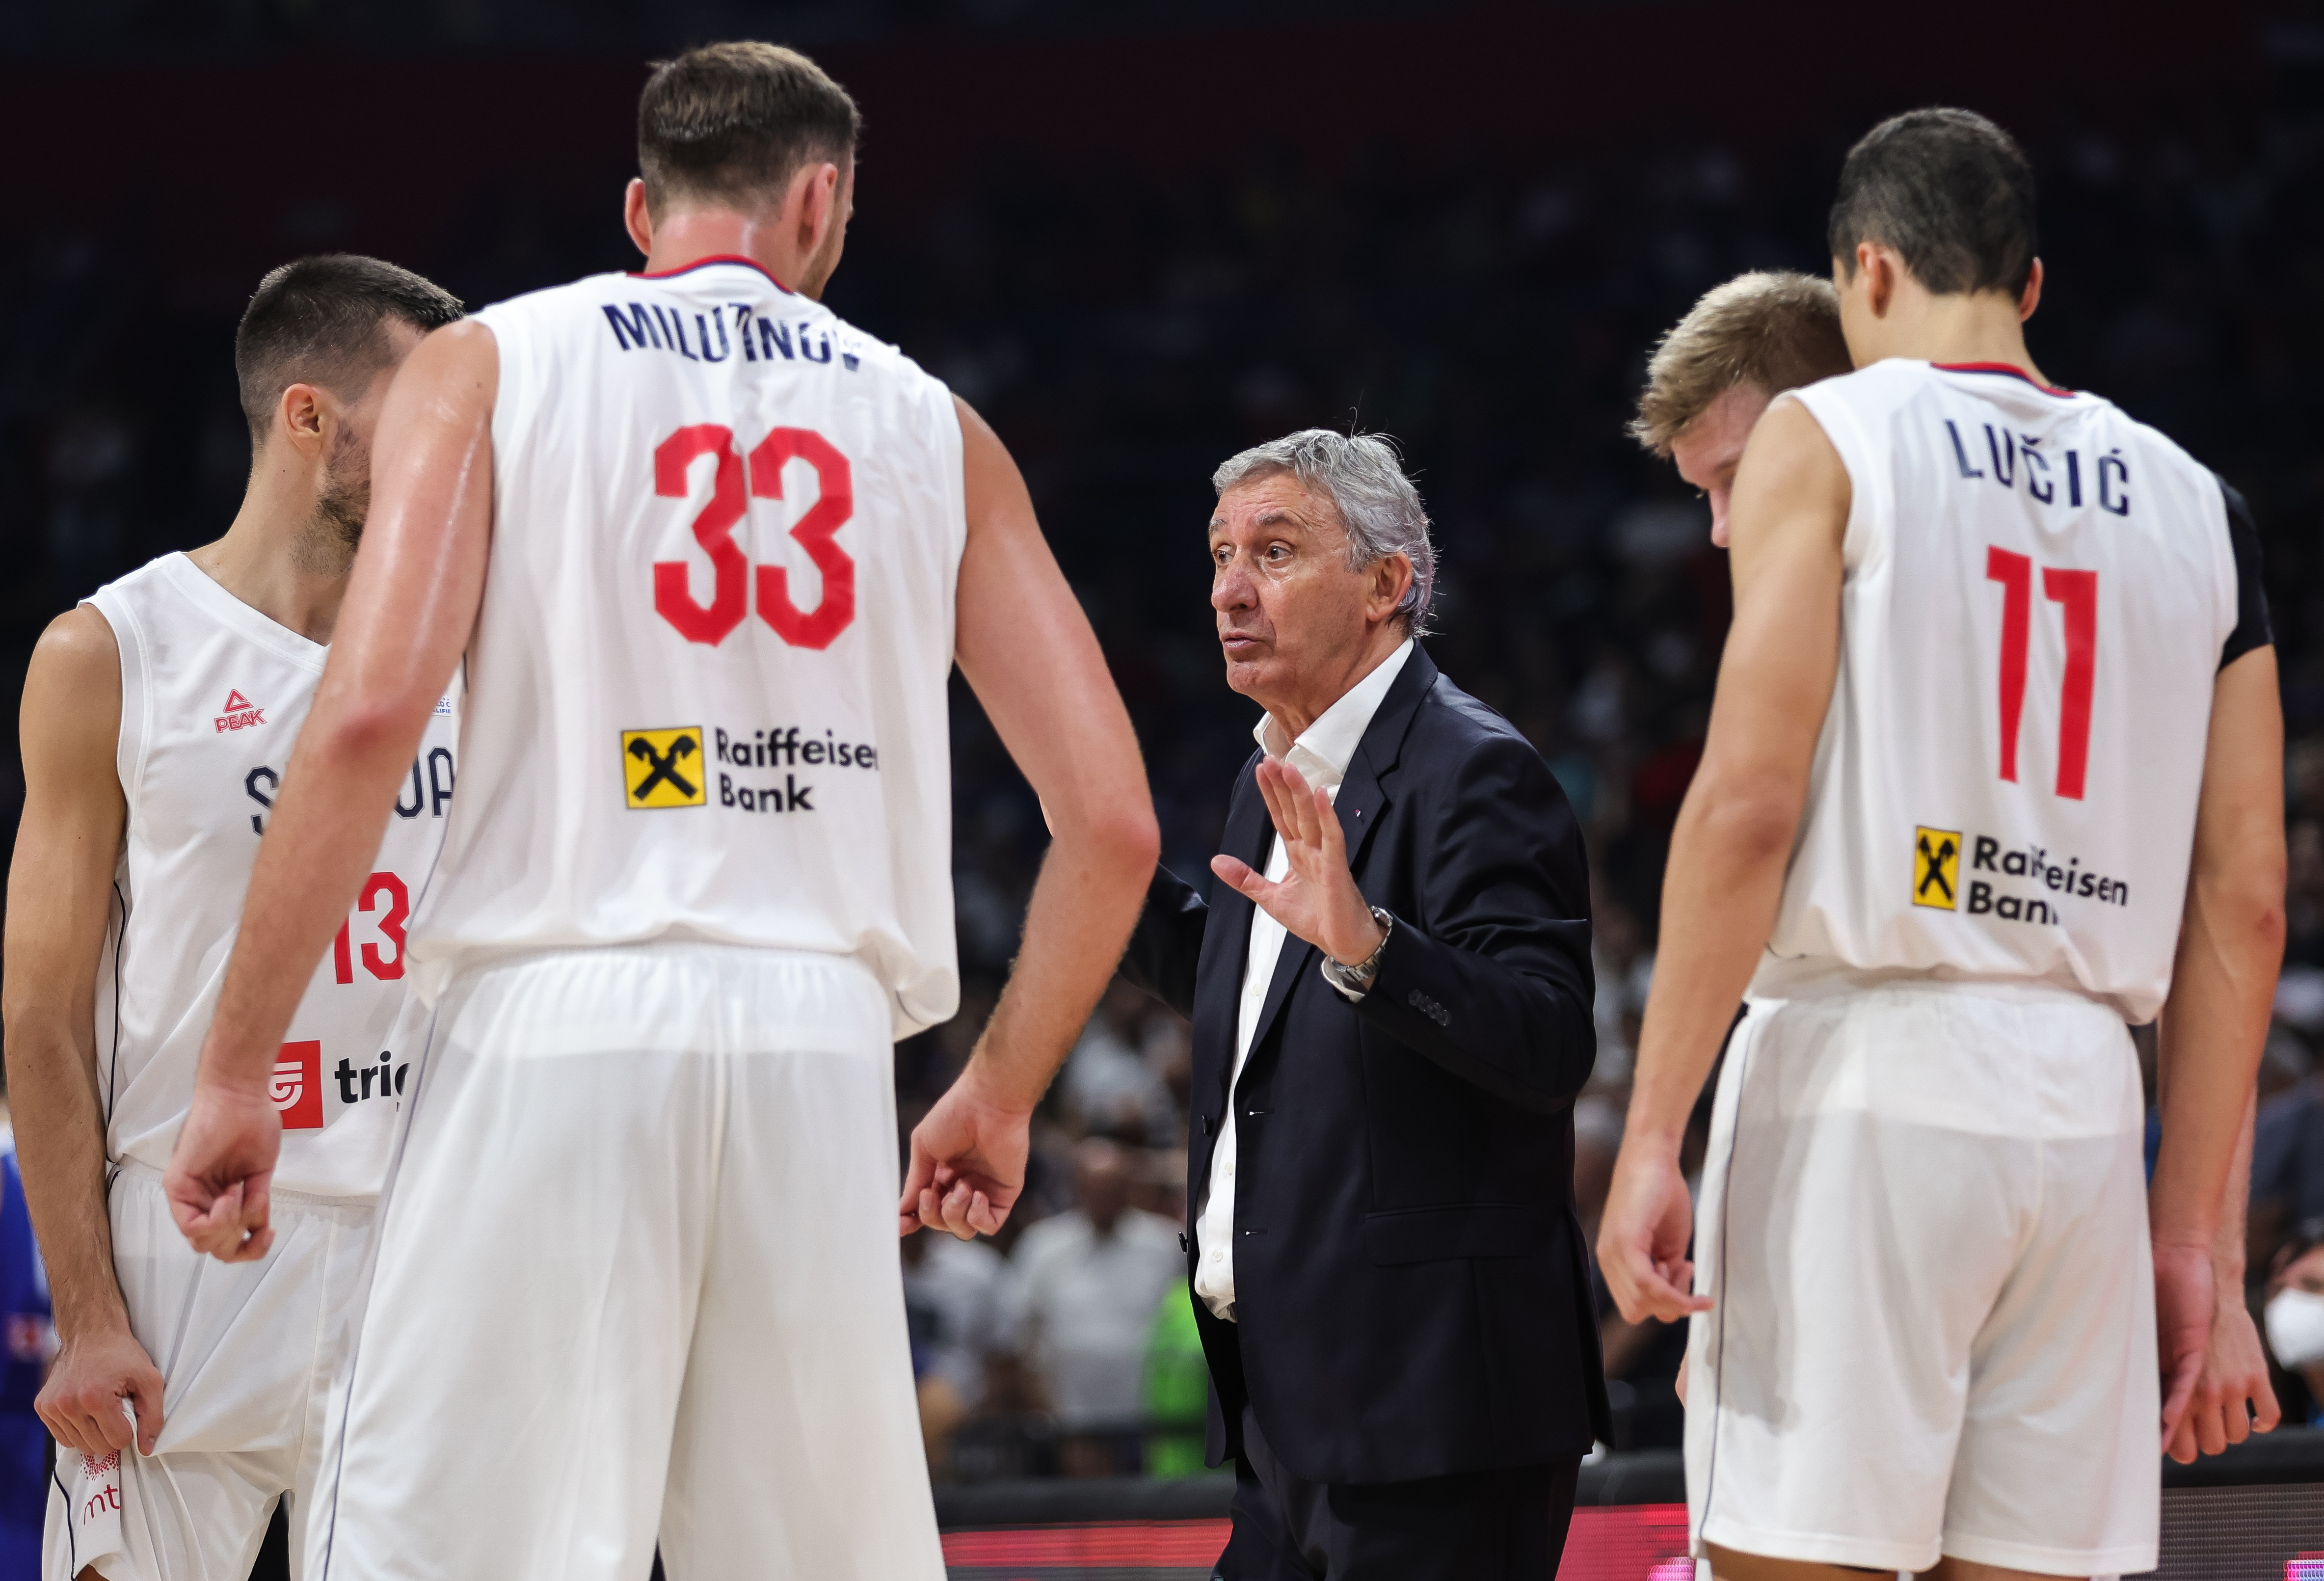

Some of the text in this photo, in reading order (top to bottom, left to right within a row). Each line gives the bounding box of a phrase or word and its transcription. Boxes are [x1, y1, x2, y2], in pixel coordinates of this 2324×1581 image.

[1944, 419, 2129, 516] LUČIĆ
[653, 423, 855, 651] 33
[1986, 544, 2098, 801] 11
[214, 708, 267, 733] PEAK
[719, 773, 815, 812] Bank
[1967, 881, 2059, 925] Ban
